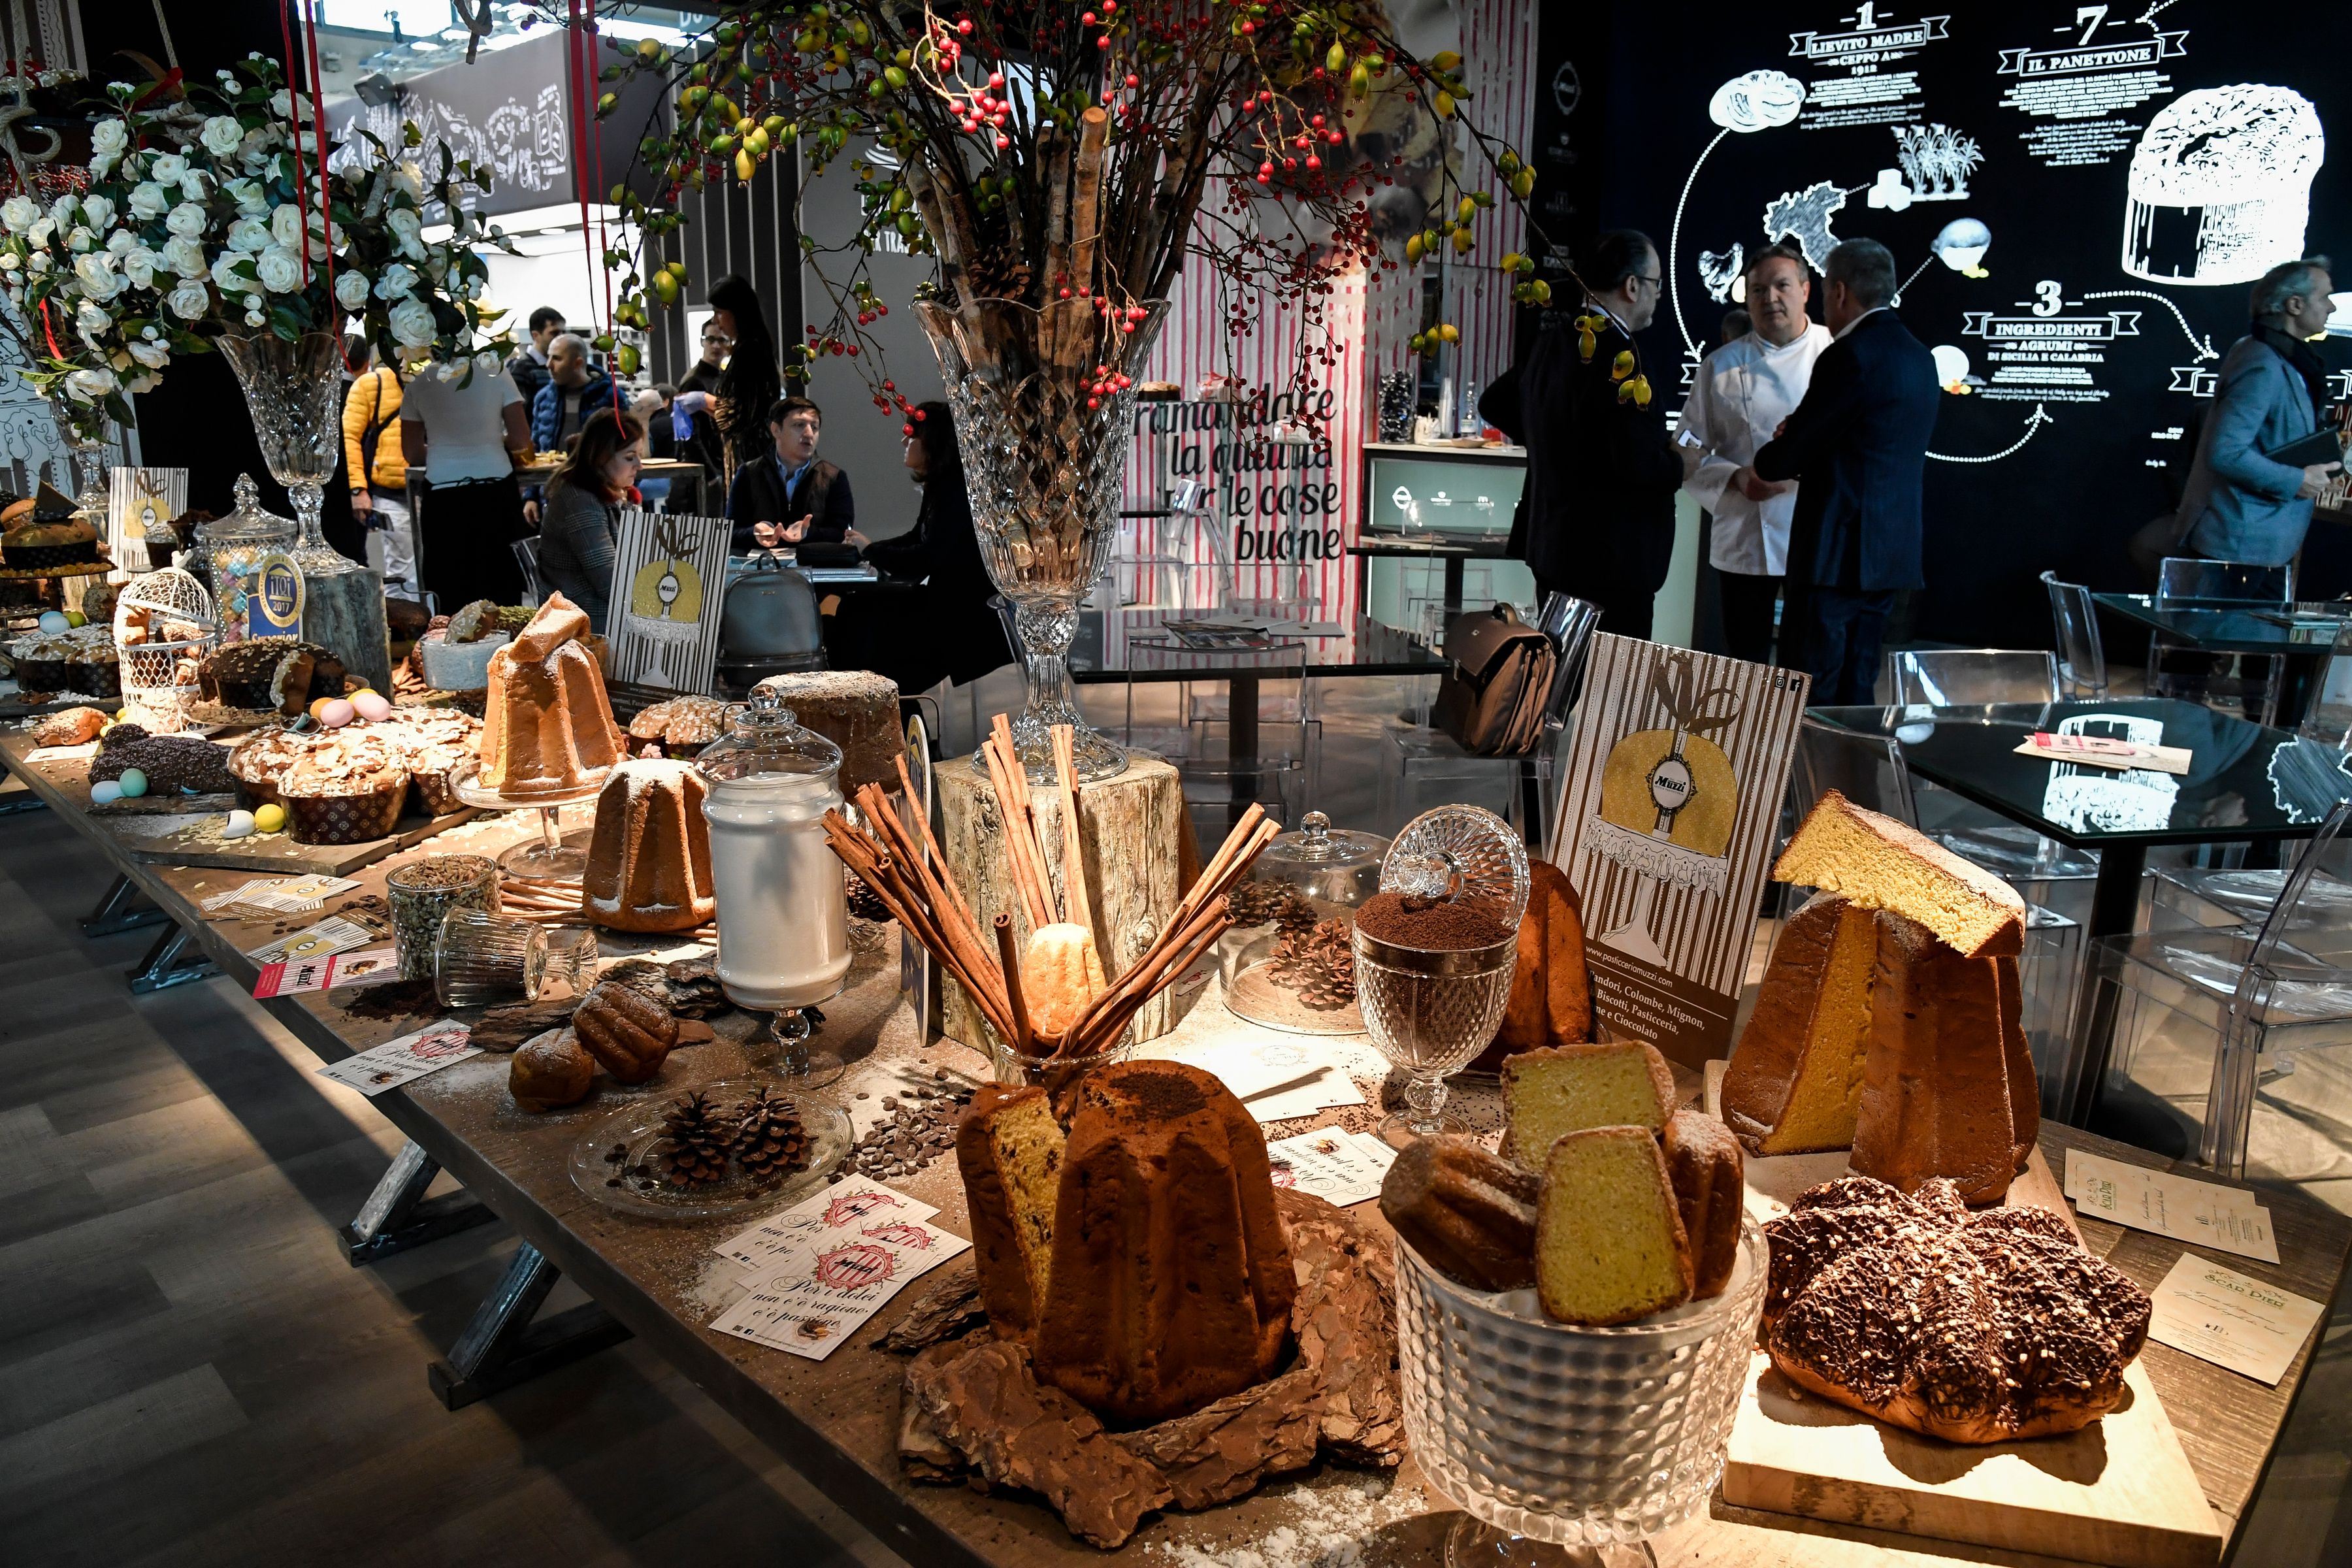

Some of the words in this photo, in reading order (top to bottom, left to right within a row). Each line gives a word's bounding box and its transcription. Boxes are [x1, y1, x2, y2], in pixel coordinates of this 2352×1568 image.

[1856, 1, 1877, 30] 1
[2076, 4, 2108, 46] 7
[1812, 37, 1868, 54] LIEVITO
[1870, 31, 1923, 48] MADRE
[1839, 52, 1880, 66] CEPPO
[1881, 52, 1891, 61] A
[2027, 59, 2046, 73] IL
[2050, 48, 2151, 70] PANETTONE
[2032, 280, 2062, 317] 3
[1995, 323, 2102, 336] INGREDIENTI
[1987, 352, 2000, 361] DI
[2001, 352, 2040, 362] SICILIA
[2040, 352, 2049, 362] E
[2050, 353, 2104, 363] CALABRIA
[2018, 340, 2073, 351] AGRUMI
[1171, 436, 1206, 476] la
[1230, 476, 1254, 517] le
[1237, 519, 1343, 560] buone
[273, 602, 289, 612] 2017
[1586, 946, 1673, 988] www.pasticceriamuzzi.com
[1590, 970, 1622, 994] Pandori,
[1624, 986, 1665, 1013] Colombe,
[1667, 1004, 1705, 1031] Mignon,
[1597, 988, 1629, 1013] Biscotti,
[1631, 1004, 1680, 1035] Pasticceria,
[1614, 1012, 1658, 1040] Cioccolato
[752, 1294, 780, 1303] non
[771, 1275, 821, 1295] Per
[836, 1288, 880, 1302] dolci
[772, 1312, 841, 1327] passione
